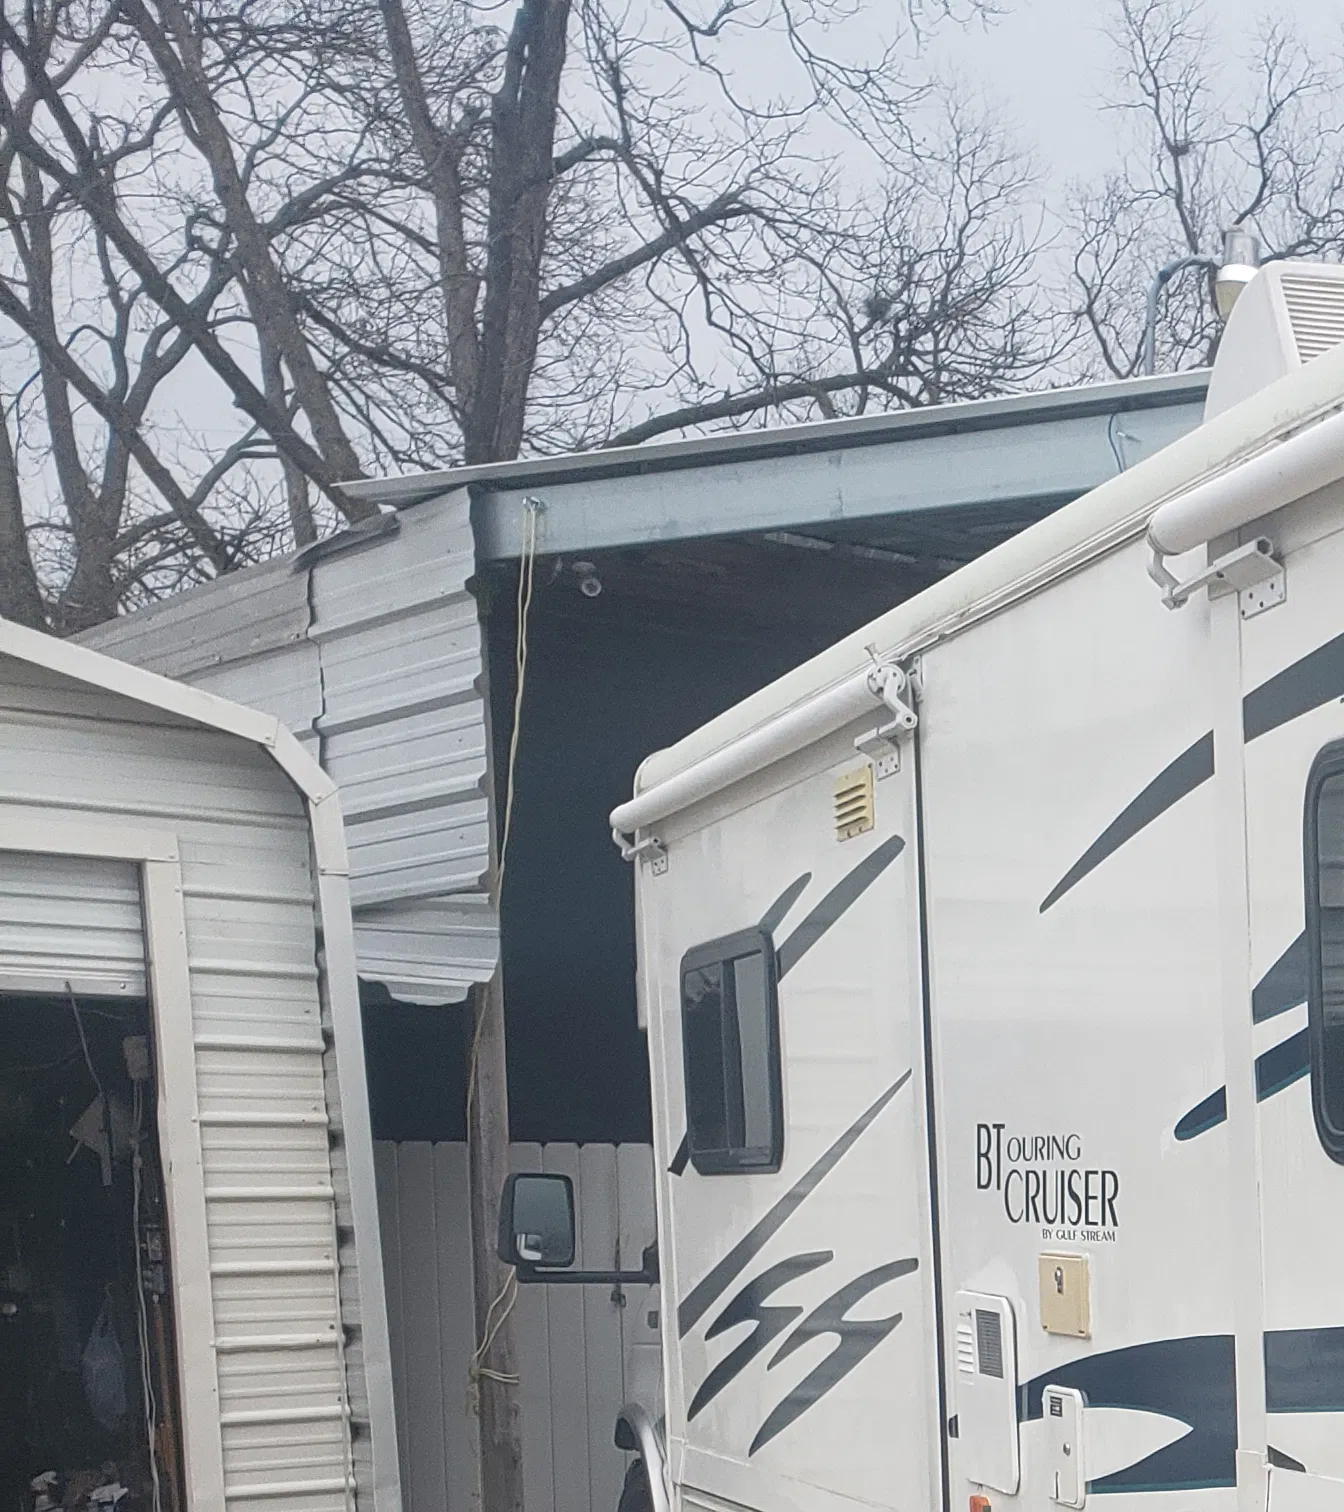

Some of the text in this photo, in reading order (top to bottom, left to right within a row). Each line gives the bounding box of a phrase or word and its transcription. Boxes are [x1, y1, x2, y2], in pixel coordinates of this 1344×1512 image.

[1004, 1169, 1119, 1227] CRUISER
[1042, 1228, 1116, 1242] BY GULF STREAM
